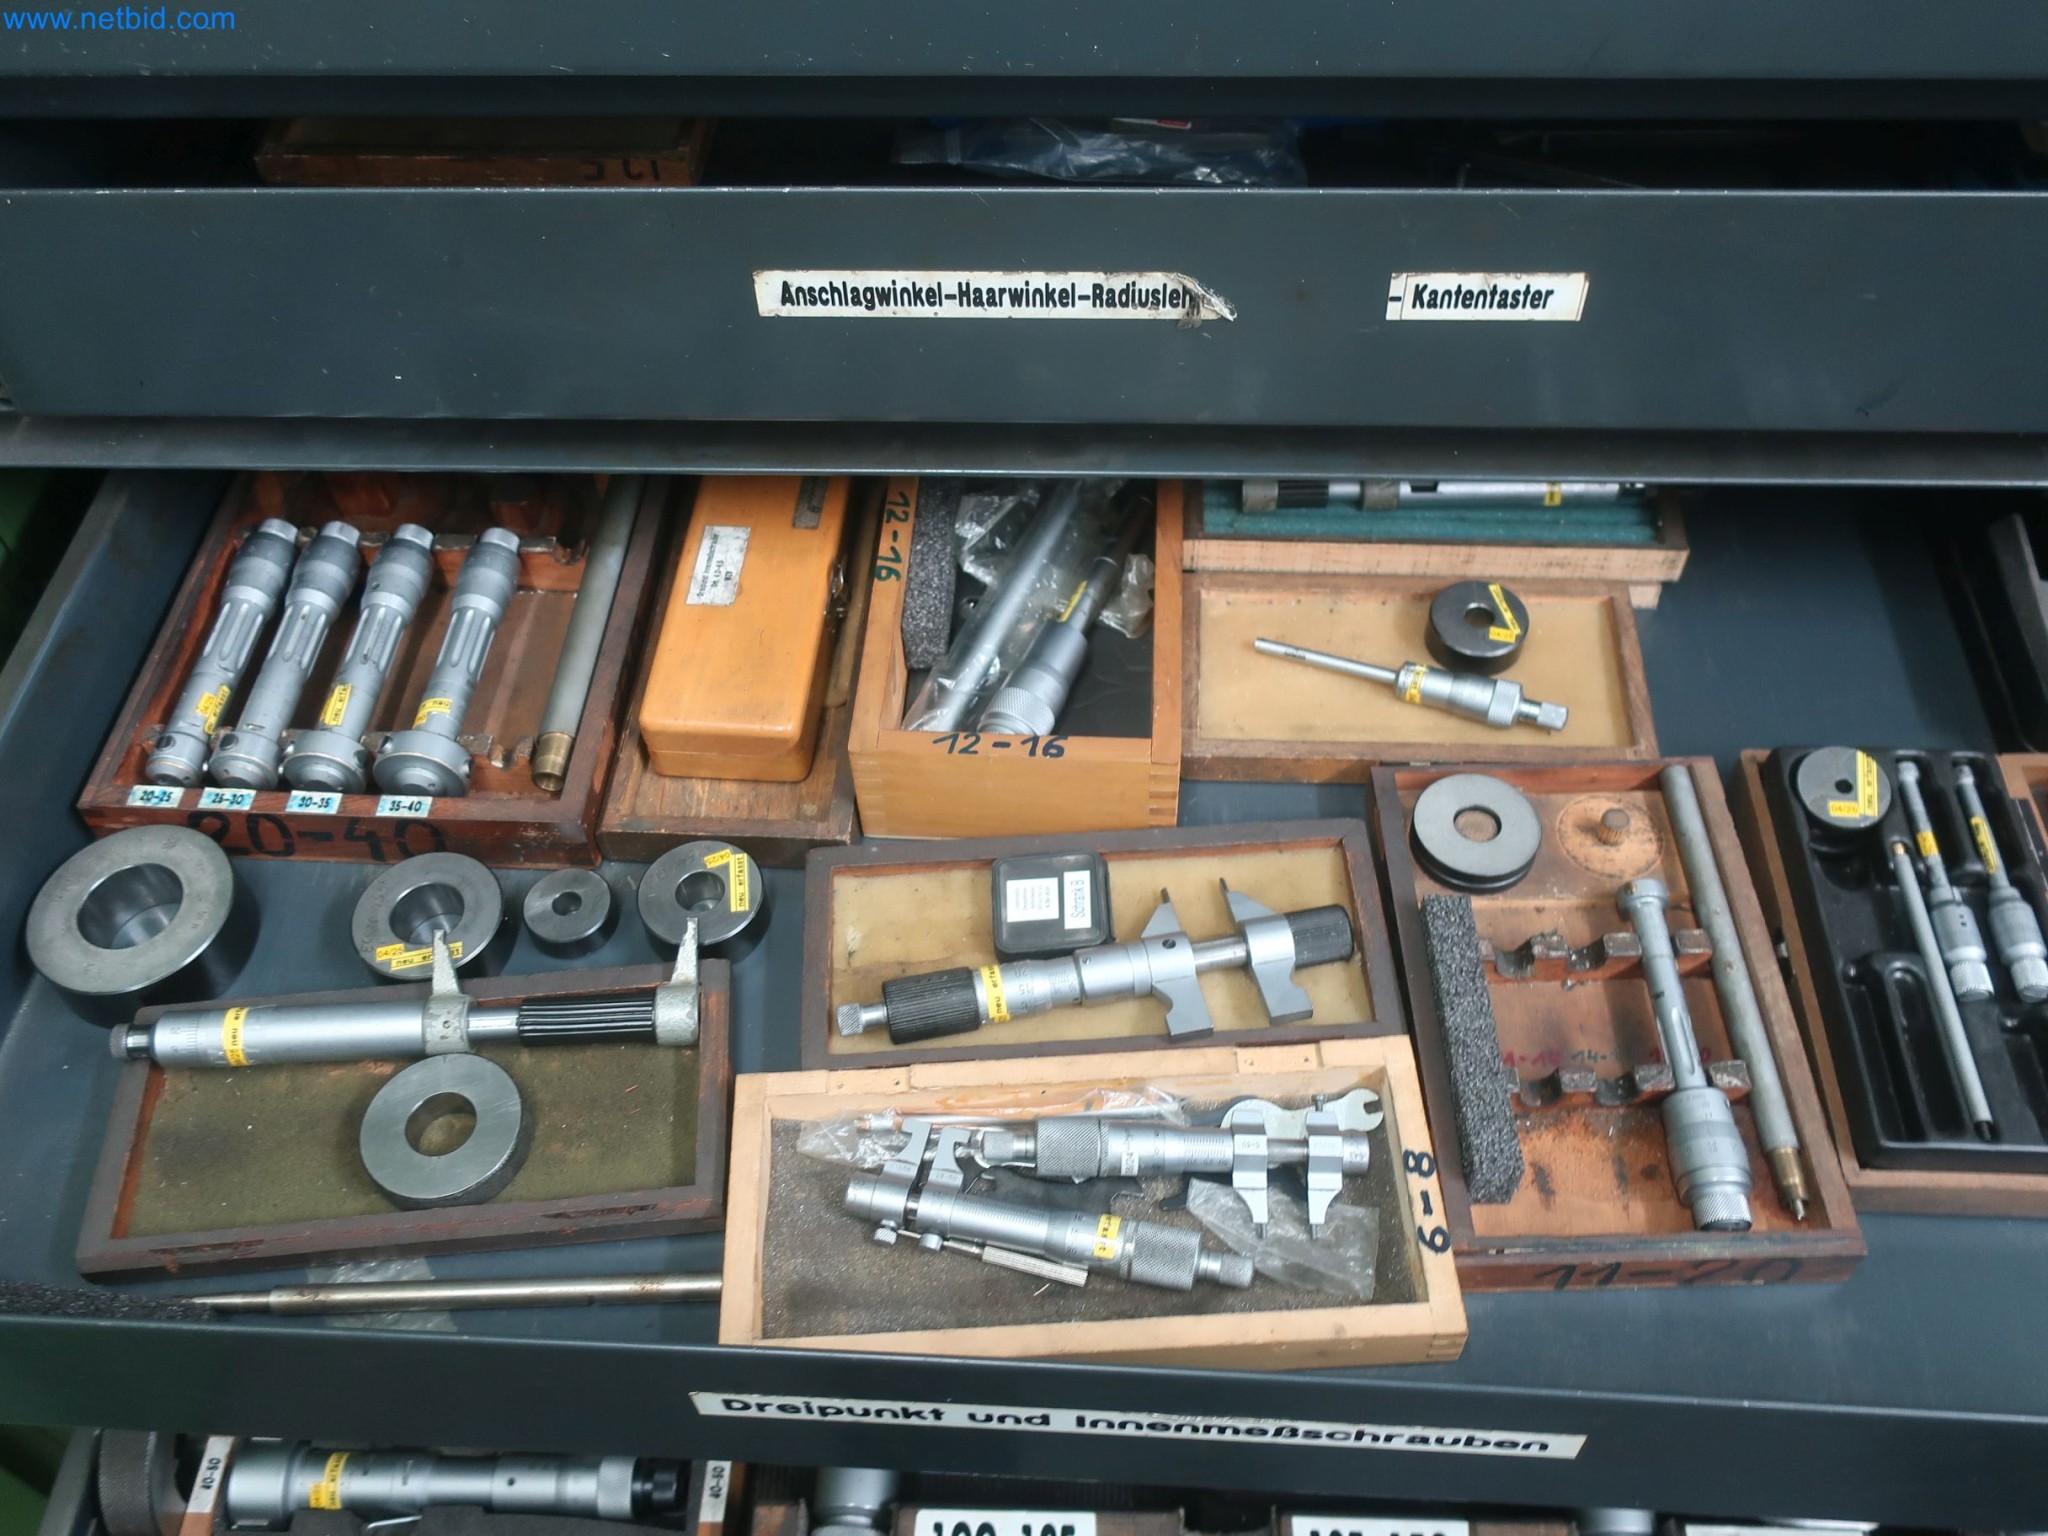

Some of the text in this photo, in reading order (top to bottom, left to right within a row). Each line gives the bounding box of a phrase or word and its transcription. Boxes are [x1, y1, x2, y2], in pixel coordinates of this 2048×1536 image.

[388, 800, 422, 813] 35-40
[721, 1398, 1550, 1453] Dreipunkt und Innenmeßschrauben
